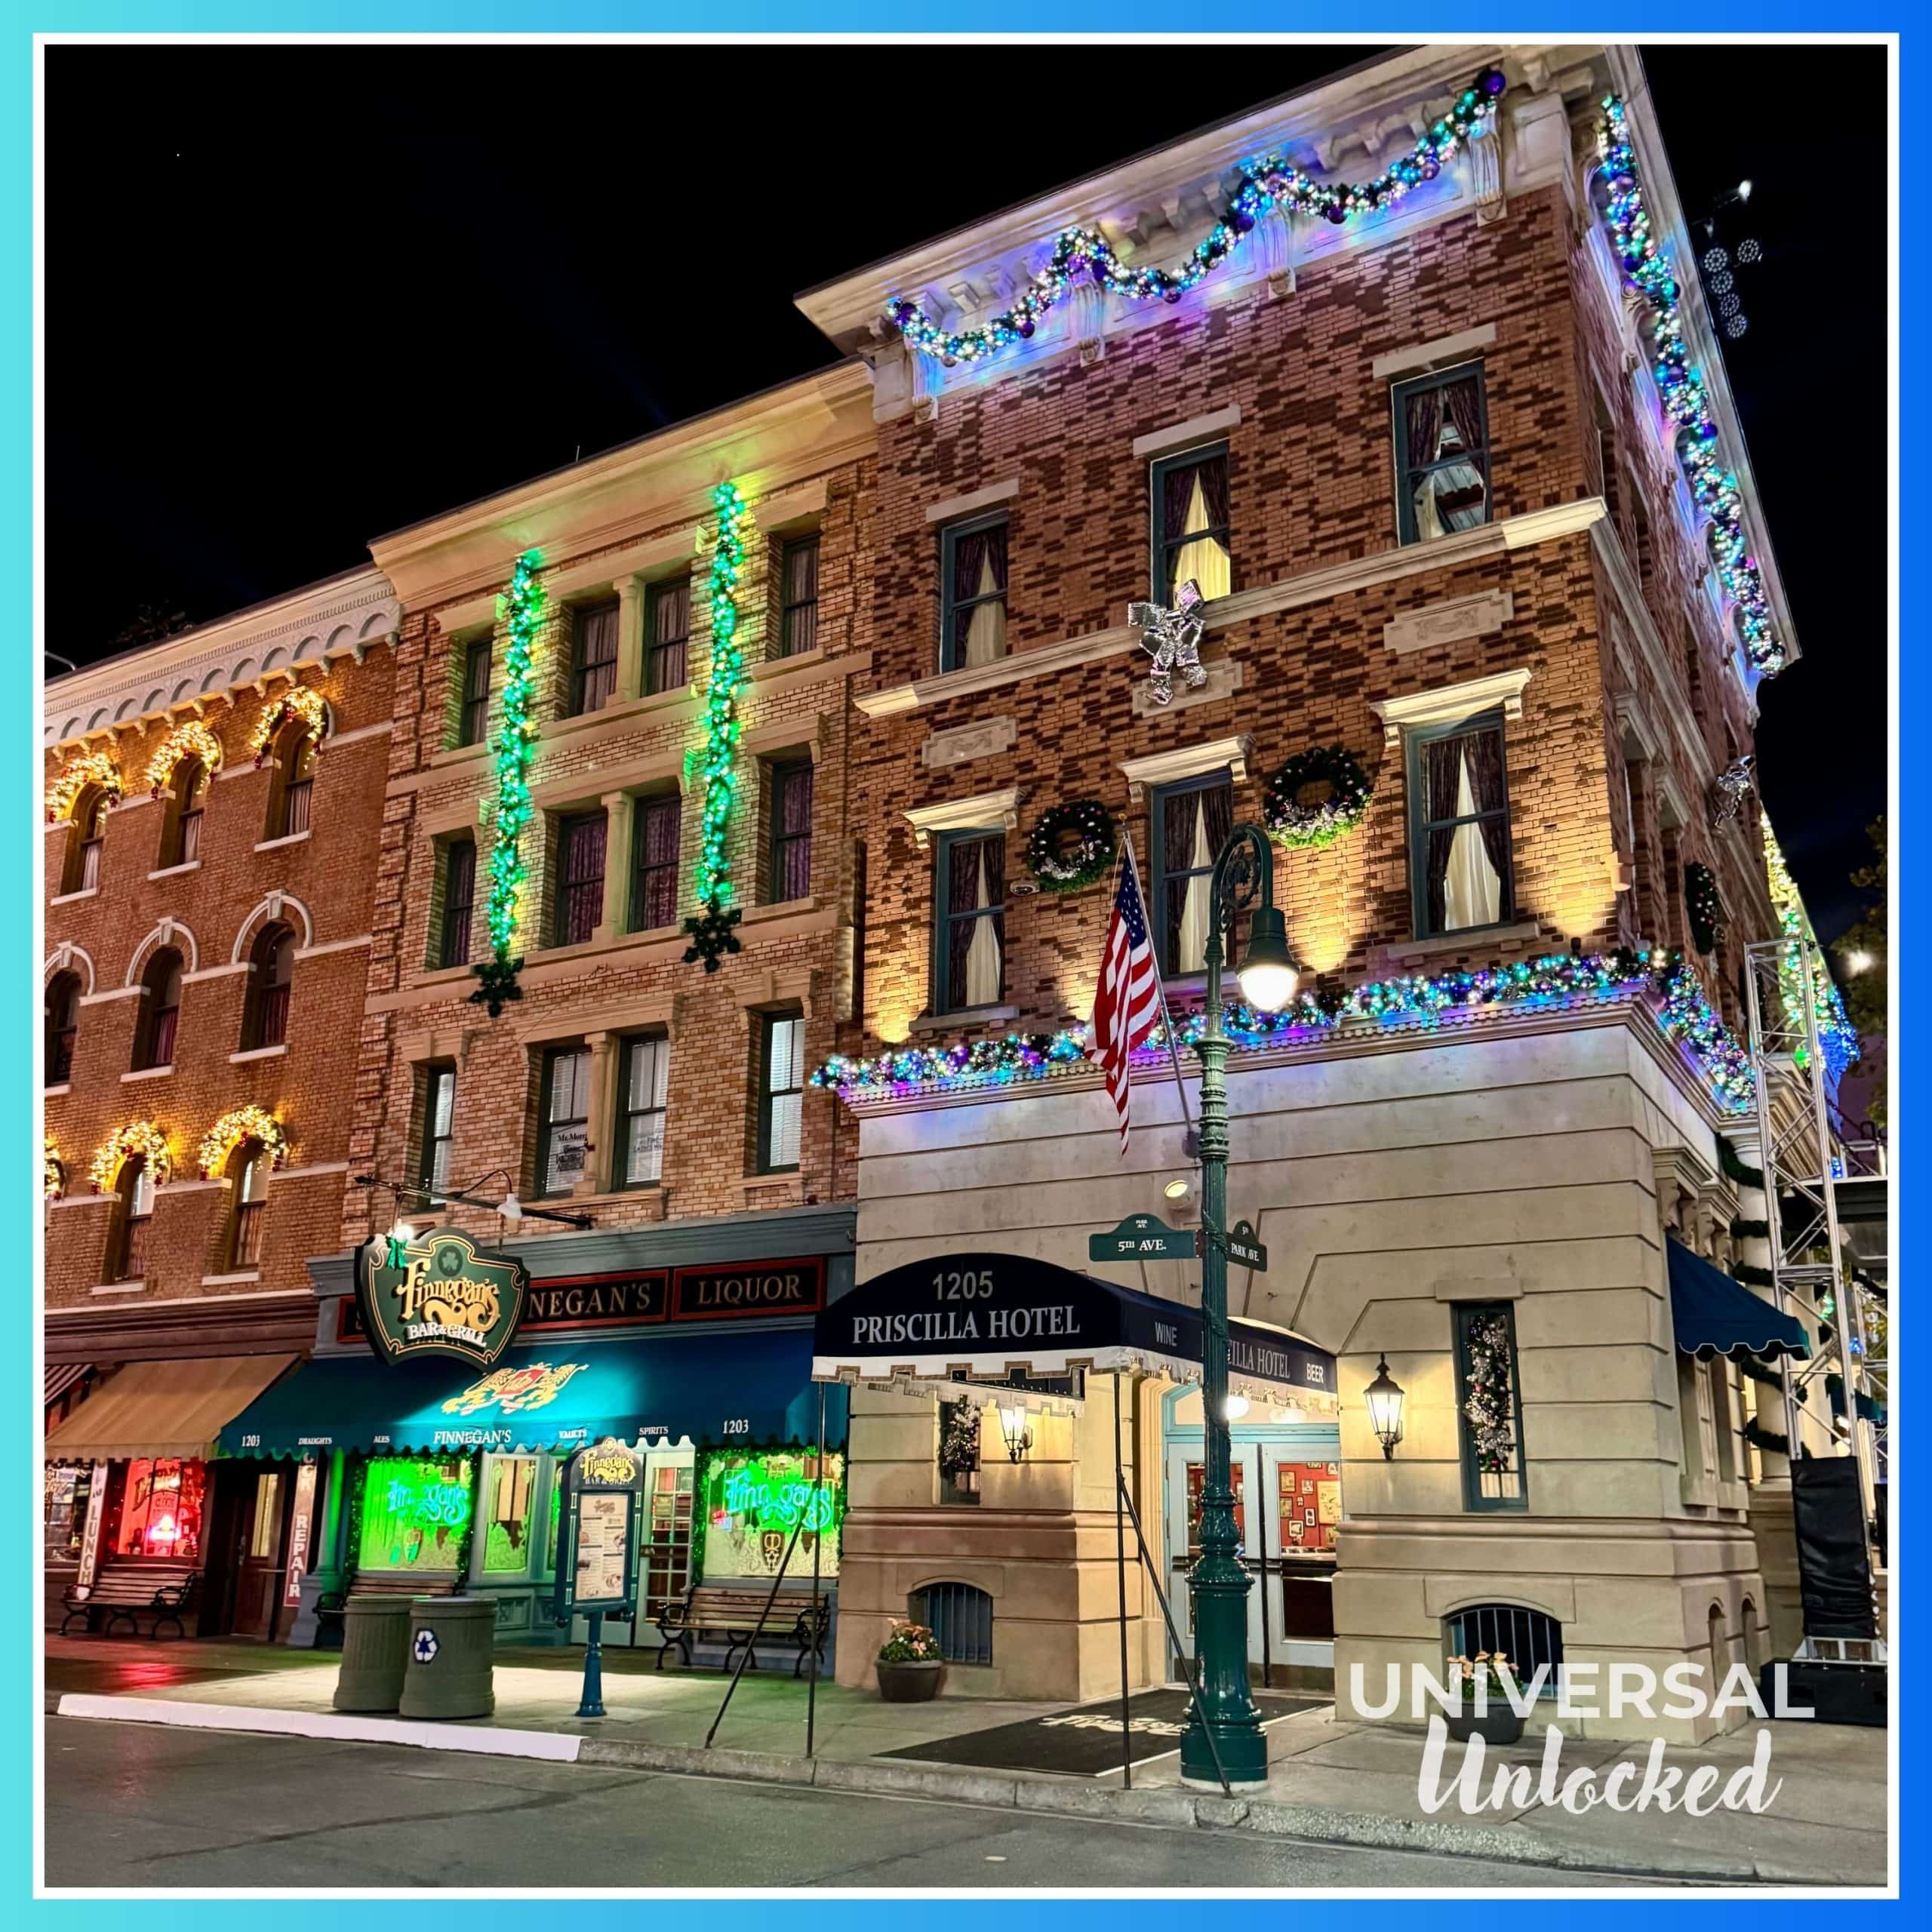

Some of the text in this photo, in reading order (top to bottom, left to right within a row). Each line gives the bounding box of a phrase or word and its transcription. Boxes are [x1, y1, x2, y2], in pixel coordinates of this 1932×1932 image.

[1139, 1239, 1167, 1251] AVE.
[1231, 1243, 1247, 1257] PARK
[396, 1257, 501, 1332] Finnegan's
[697, 1274, 803, 1306] LIQUOR
[932, 1270, 994, 1301] 1205
[852, 1305, 1081, 1344] PRISCILLA HOTEL
[1155, 1321, 1177, 1347] WINE
[1257, 1348, 1291, 1379] HOTEL
[1306, 1362, 1324, 1383] BEER
[373, 1435, 390, 1444] ALES
[433, 1429, 512, 1444] FINNEGAN'S
[638, 1426, 669, 1435] SPIRITS
[722, 1419, 749, 1434] 1203
[242, 1435, 260, 1447] 1203
[580, 1450, 636, 1482] Finnegan's
[80, 1505, 97, 1583] LUNCH
[288, 1515, 308, 1598] REPAIR
